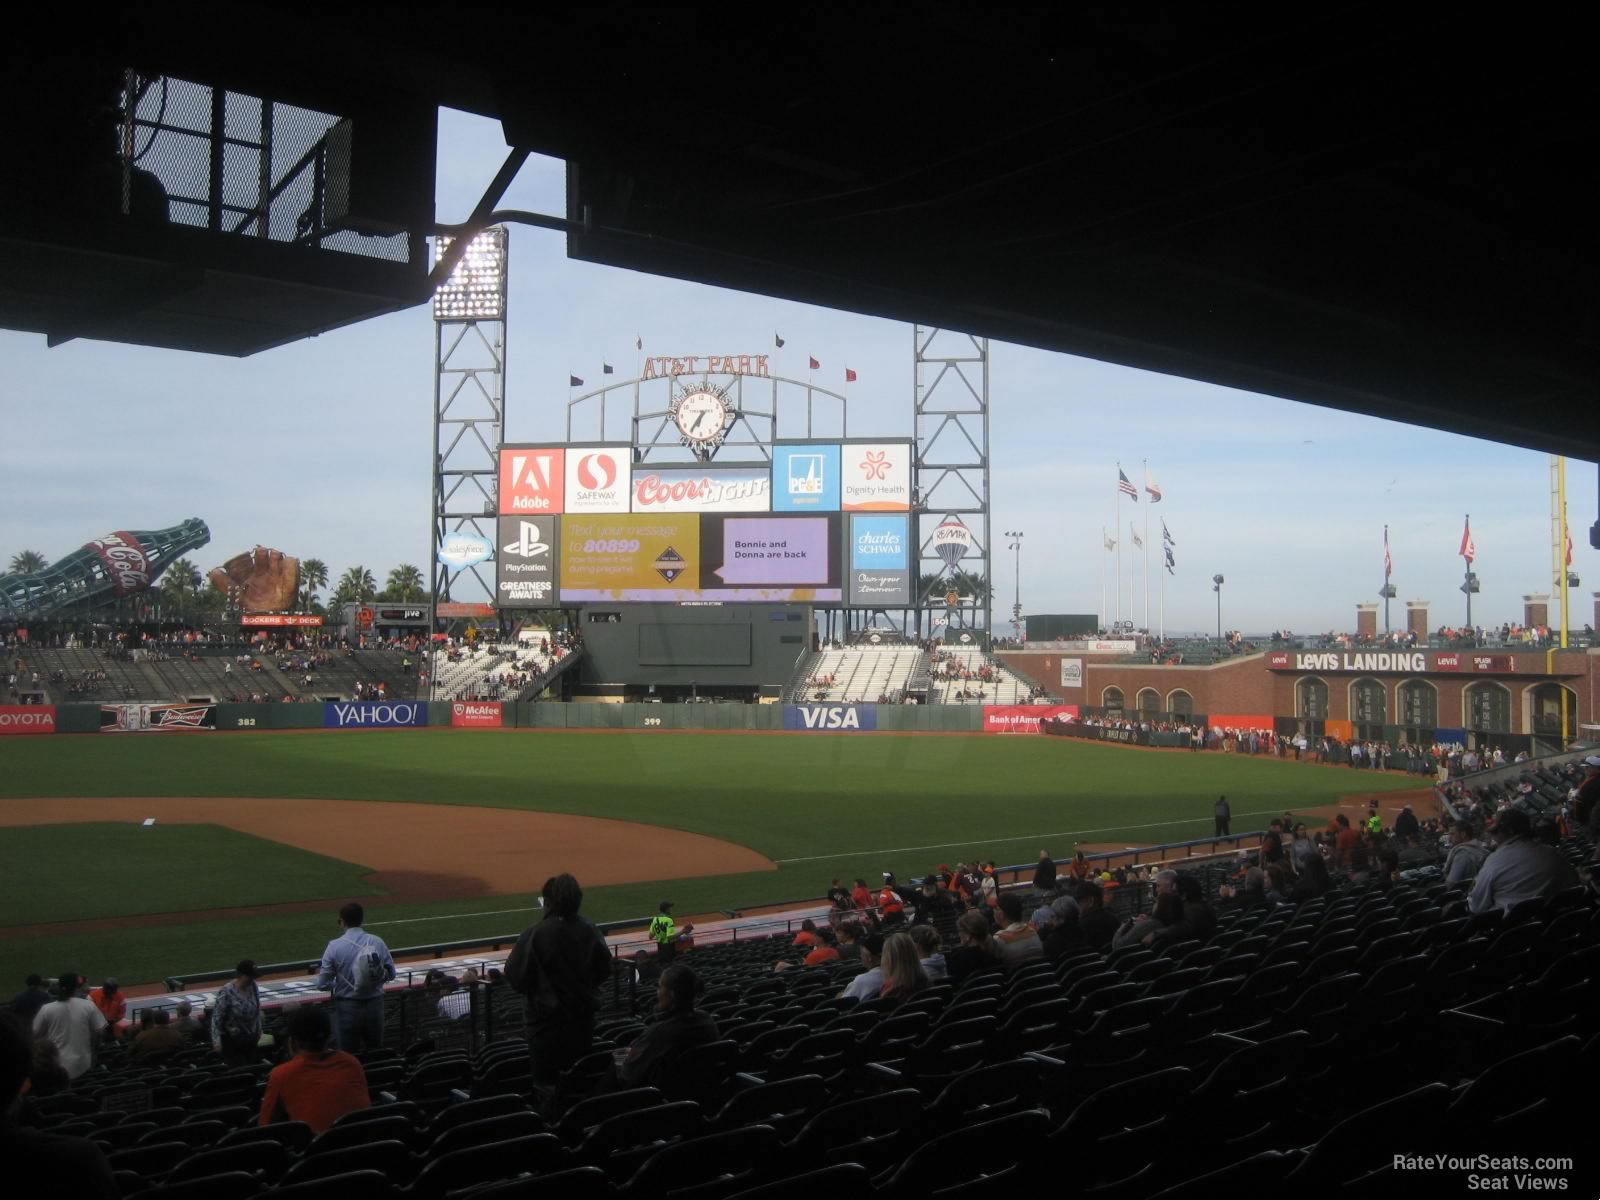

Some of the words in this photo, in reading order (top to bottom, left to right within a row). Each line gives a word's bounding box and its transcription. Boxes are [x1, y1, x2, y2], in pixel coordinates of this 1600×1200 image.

[641, 356, 699, 381] AT&T
[708, 355, 769, 378] PARK
[635, 474, 710, 505] Coors
[791, 477, 822, 492] PG&E
[577, 492, 617, 500] SAFEWAY
[846, 486, 875, 496] Dignity
[877, 486, 905, 494] Health
[512, 496, 550, 509] Adobe
[858, 532, 900, 544] charles
[937, 529, 967, 541] RE/MAX
[583, 539, 641, 552] 80899
[735, 540, 771, 548] Bonnie
[774, 540, 787, 548] and
[858, 544, 901, 554] SCHWAB
[735, 551, 764, 559] Donna
[784, 551, 807, 559] back
[505, 564, 547, 573] PlayStation
[500, 581, 552, 590] GREATNESS
[509, 590, 544, 599] AWAITS
[404, 610, 420, 619] jive
[1344, 653, 1426, 671] LANDING
[333, 704, 418, 726] YAHOO!
[465, 706, 500, 715] McAfee
[238, 718, 256, 726] 382
[644, 717, 661, 726] 399
[797, 707, 861, 729] VISA
[989, 715, 1010, 724] Bank
[1010, 715, 1019, 724] of
